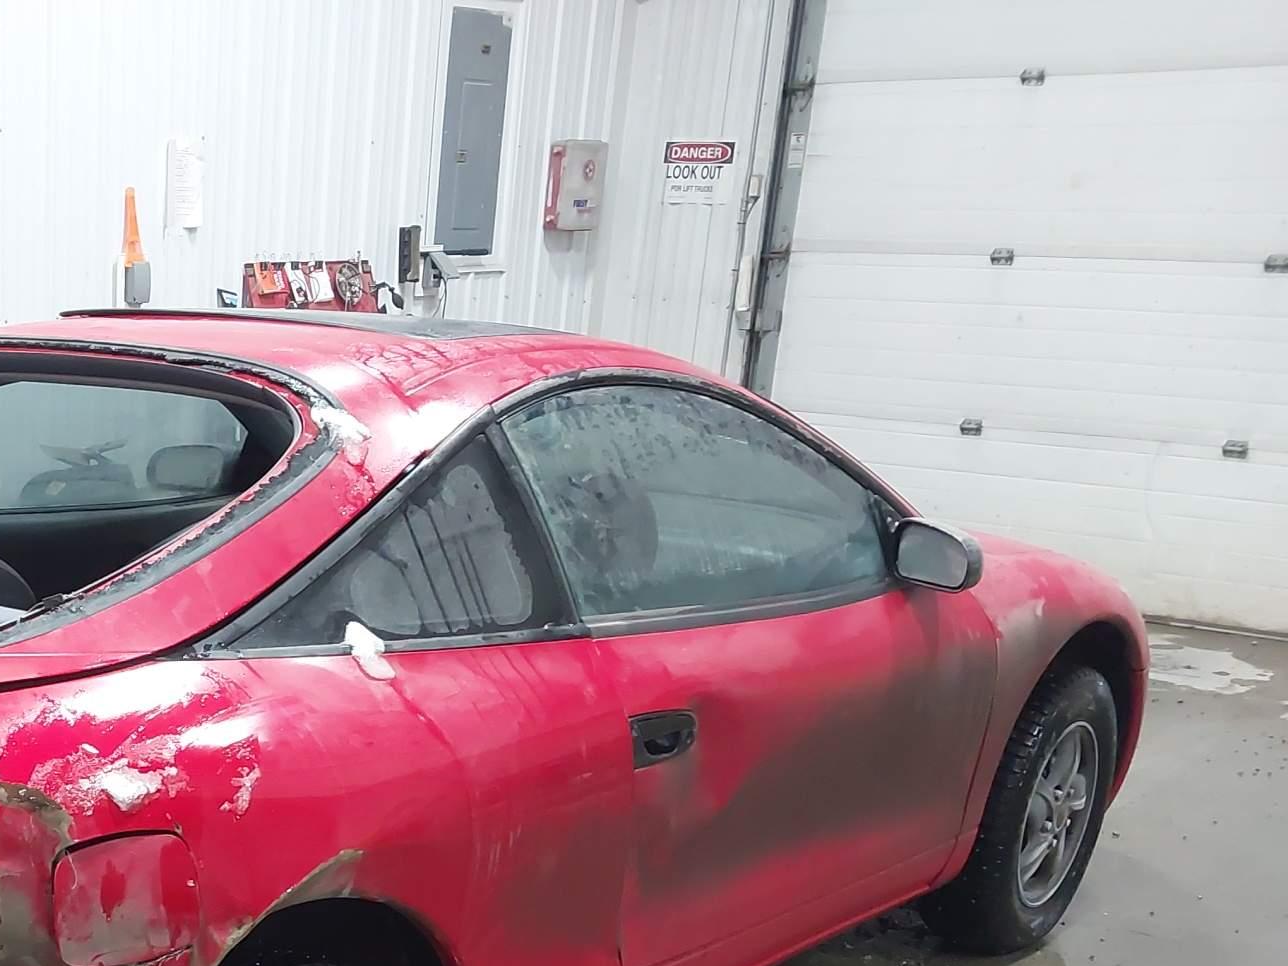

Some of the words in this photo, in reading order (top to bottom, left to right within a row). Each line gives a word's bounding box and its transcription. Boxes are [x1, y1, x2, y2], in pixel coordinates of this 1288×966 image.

[671, 146, 722, 159] DANGER
[666, 165, 699, 179] LOOK
[701, 165, 724, 180] OUT
